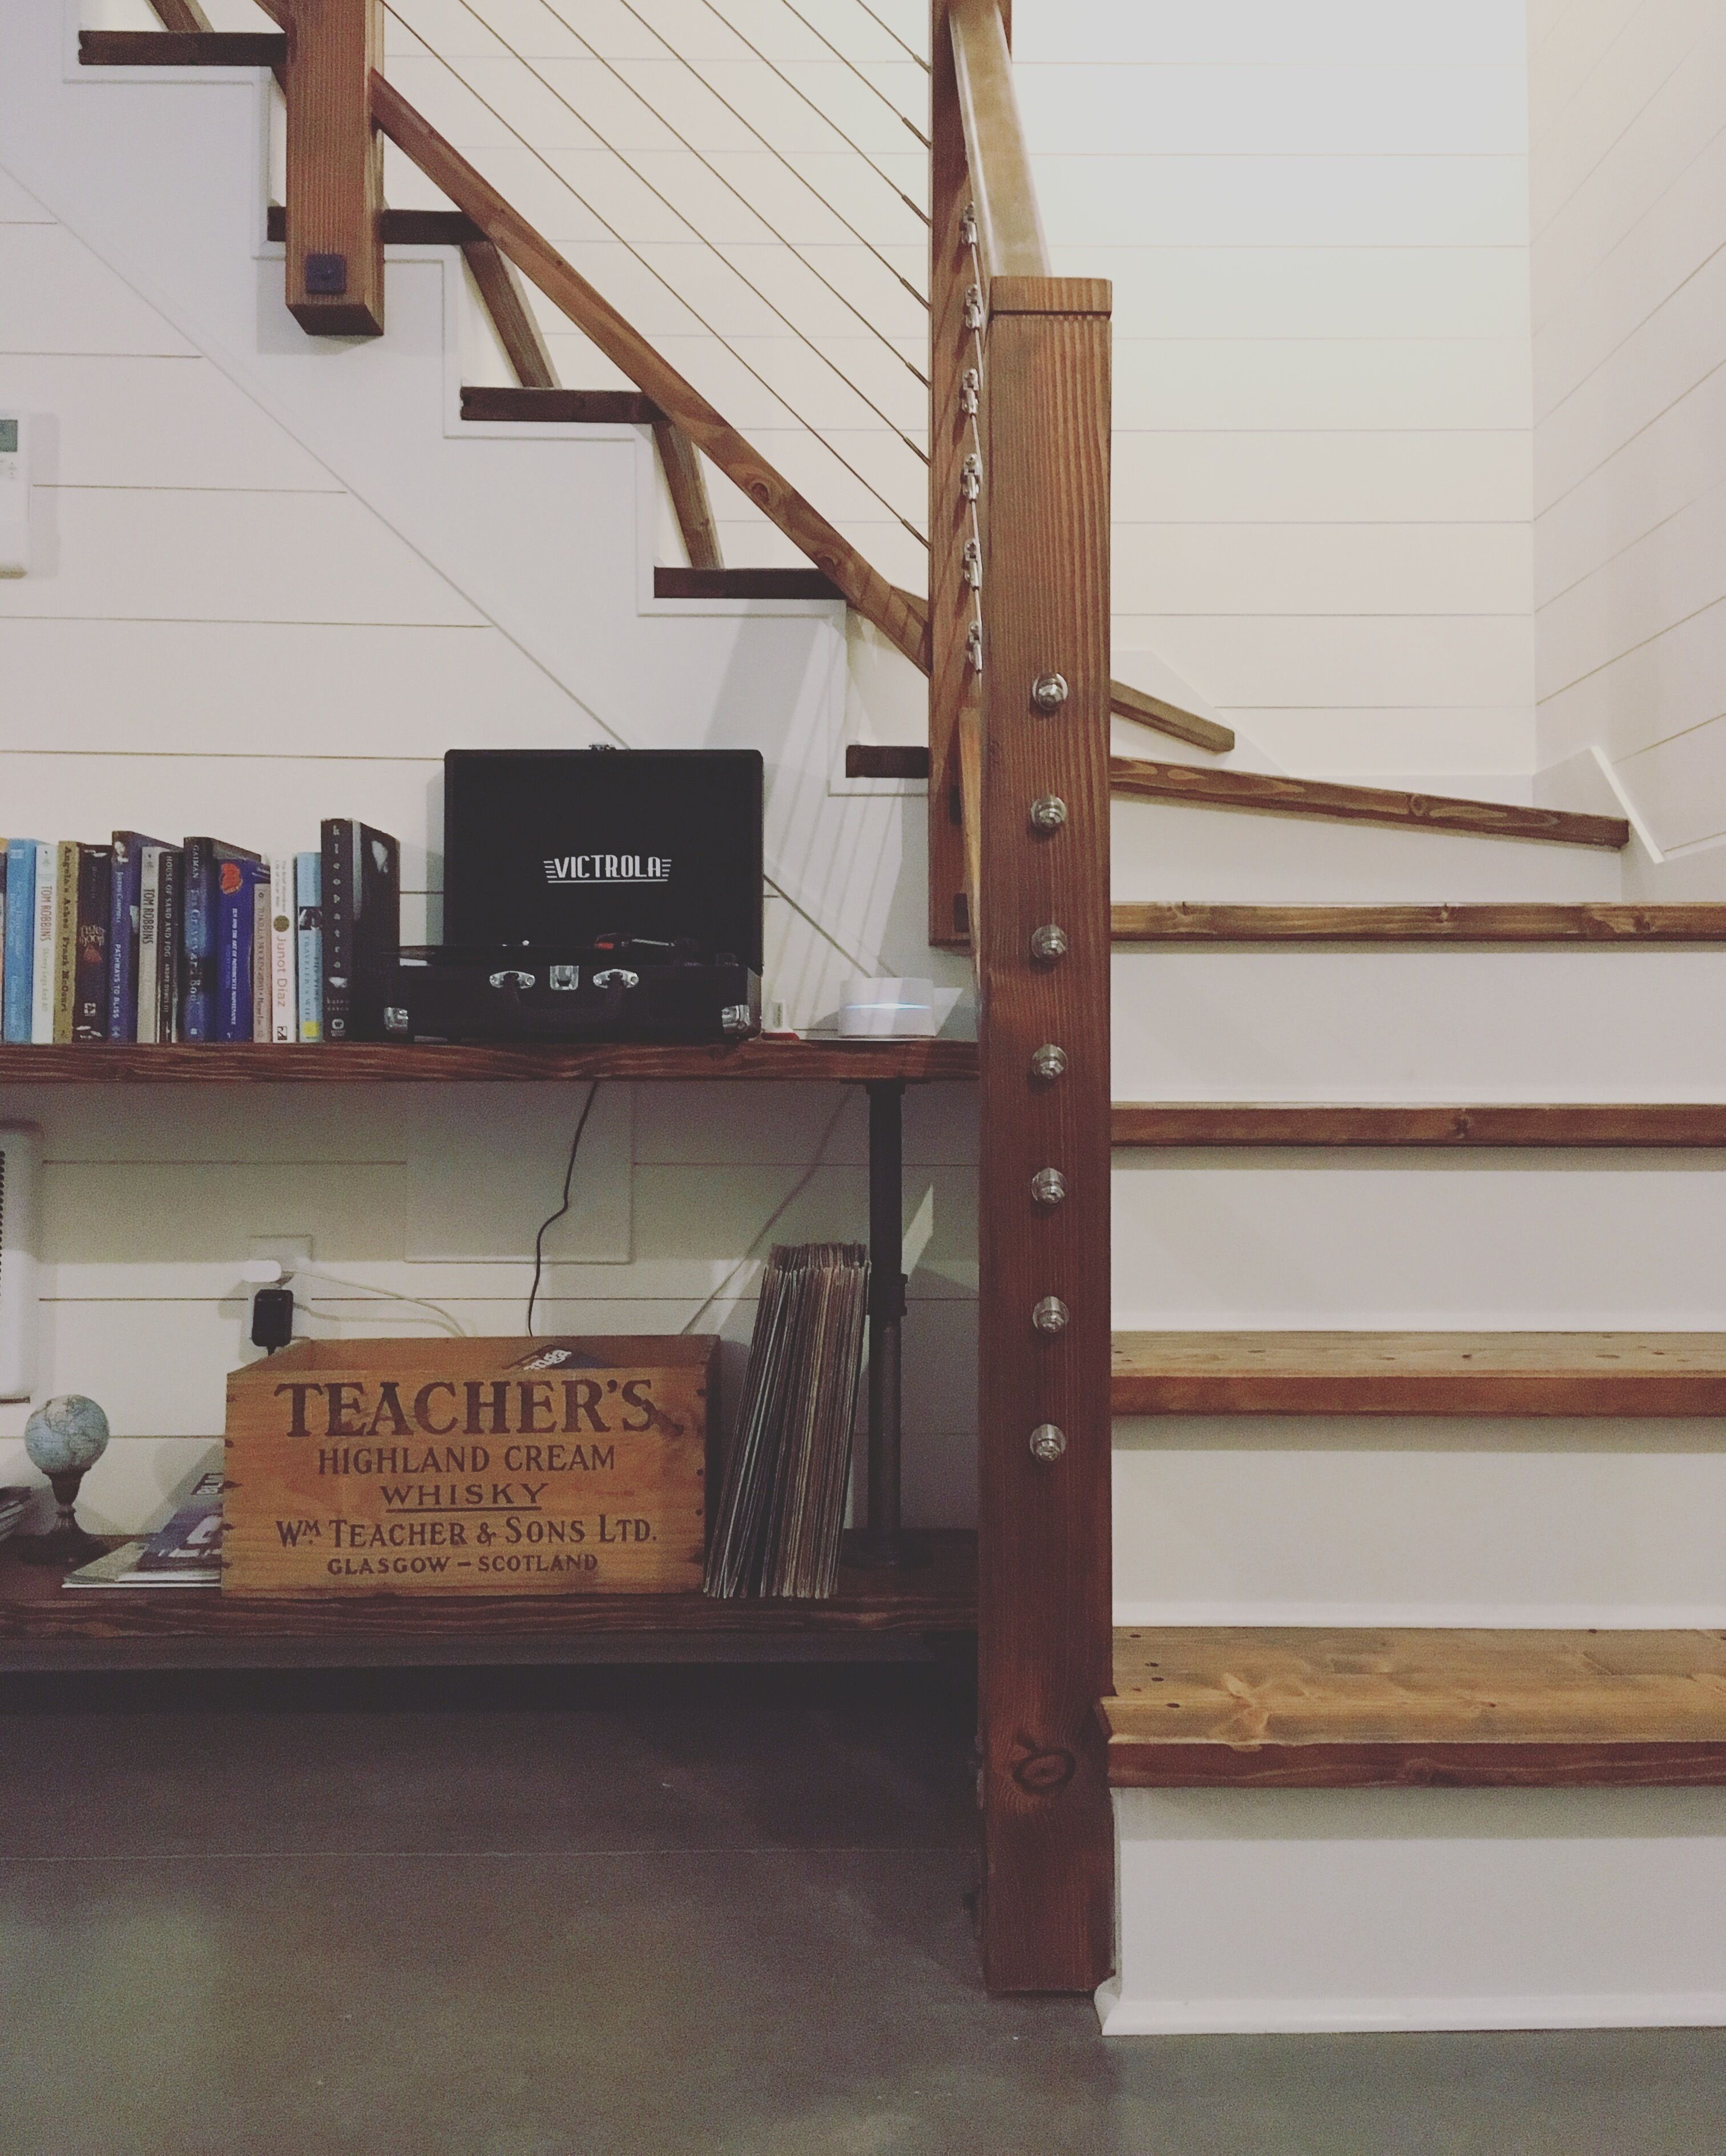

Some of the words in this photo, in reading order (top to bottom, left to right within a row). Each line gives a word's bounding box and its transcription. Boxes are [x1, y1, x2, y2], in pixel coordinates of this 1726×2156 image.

[554, 855, 661, 878] VICTROLA
[41, 886, 53, 902] TOM
[143, 889, 155, 906] TOM
[165, 883, 172, 895] OF
[40, 905, 53, 942] ROBBINS
[142, 907, 155, 944] ROBBINS
[113, 943, 122, 983] PATHWAYS
[277, 935, 287, 972] Junot
[113, 985, 121, 995] TO
[273, 1378, 656, 1437] TEACHER'S
[318, 1446, 490, 1475] HIGHLAND
[504, 1444, 615, 1472] CREAM
[379, 1483, 549, 1505] WHISKY
[329, 1519, 467, 1548] TEACHER
[476, 1521, 497, 1546] &
[505, 1516, 586, 1543] SONS
[599, 1513, 657, 1544] LTD.
[327, 1556, 451, 1575] GLASGOW
[478, 1554, 598, 1572] SCOTLAND
